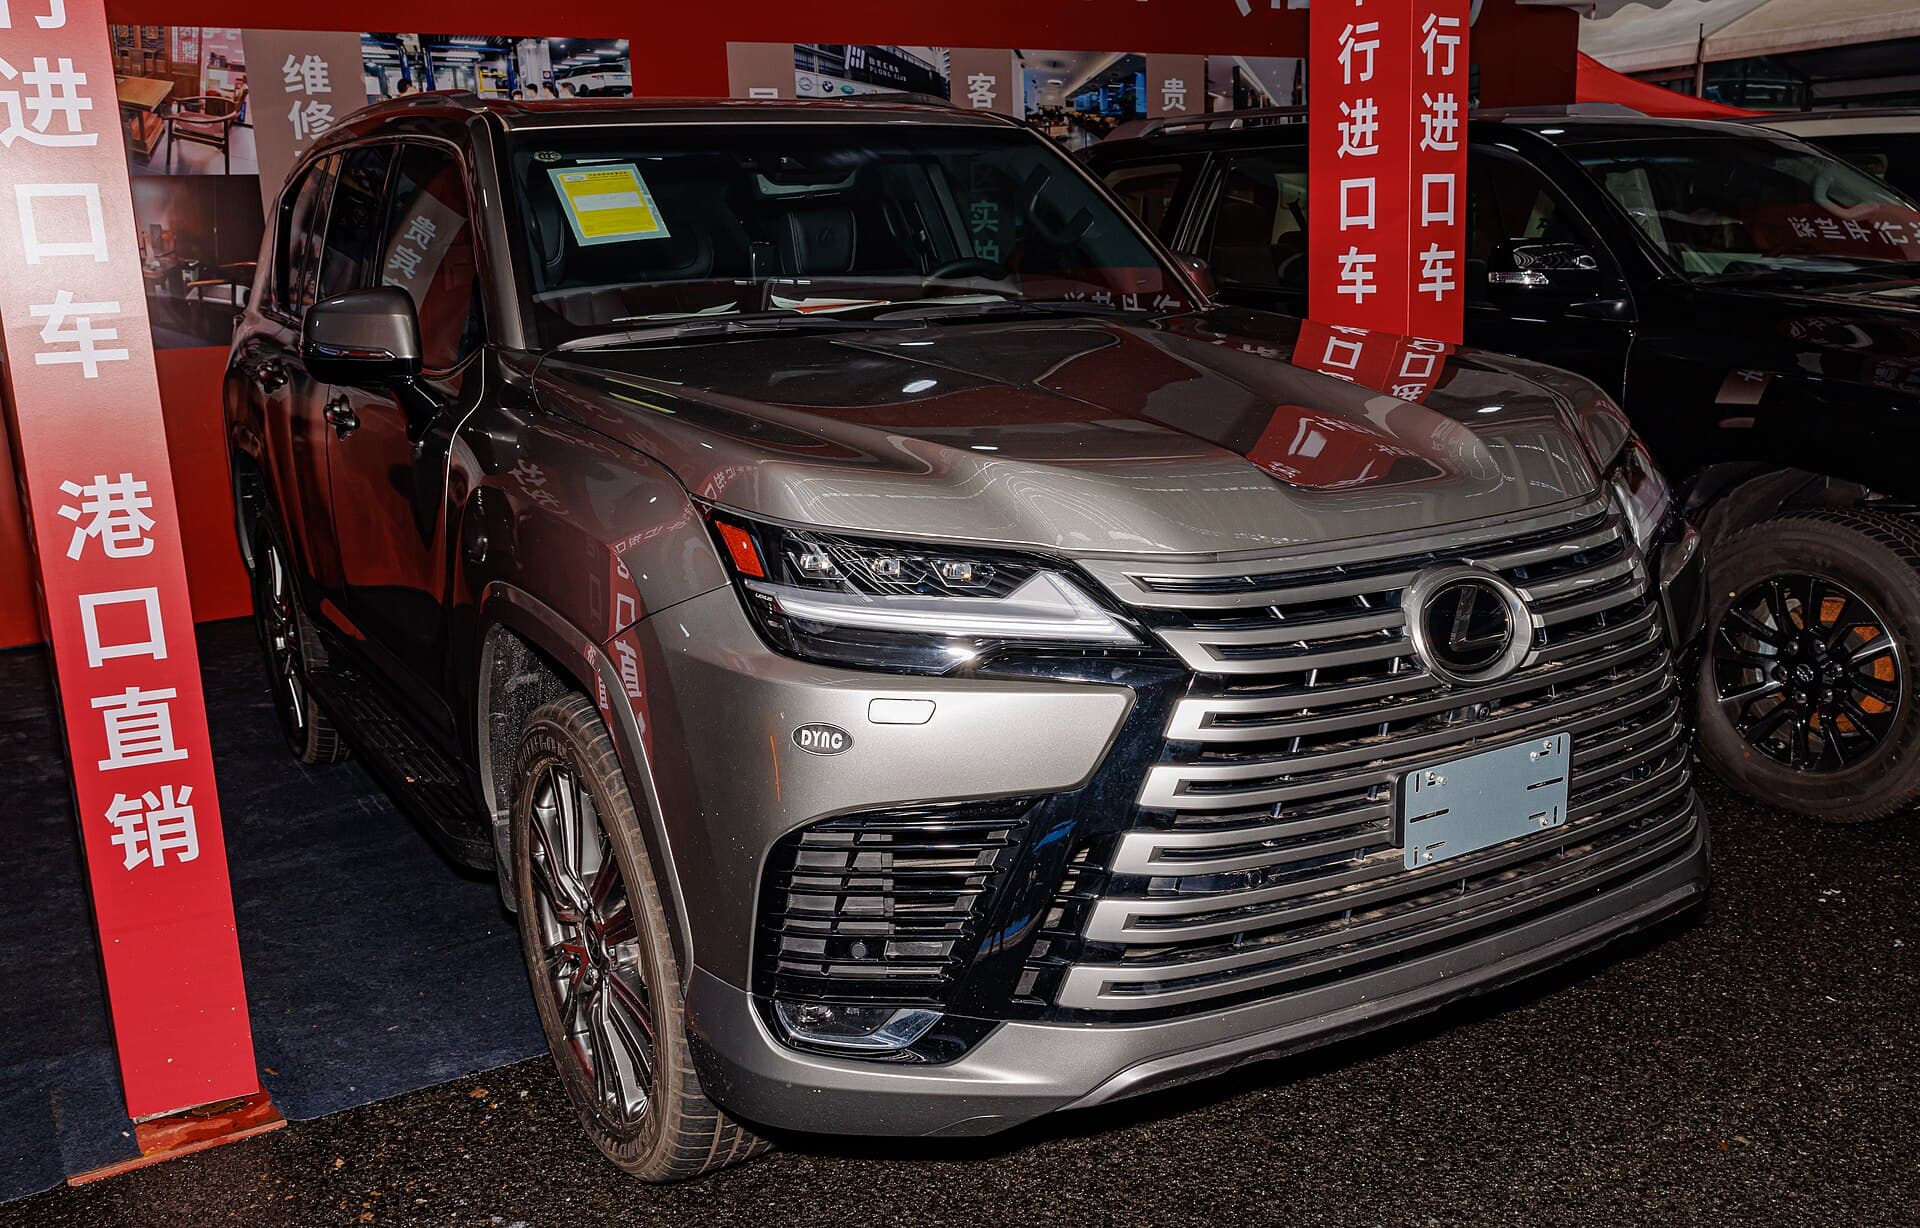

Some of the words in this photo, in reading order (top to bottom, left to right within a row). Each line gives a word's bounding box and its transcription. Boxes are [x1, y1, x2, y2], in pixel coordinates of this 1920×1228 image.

[282, 54, 335, 157] 维修
[1337, 0, 1380, 304] 行进口车
[1419, 13, 1461, 301] 行进口车
[57, 473, 199, 870] 港口直销
[801, 729, 843, 749] DYNC
